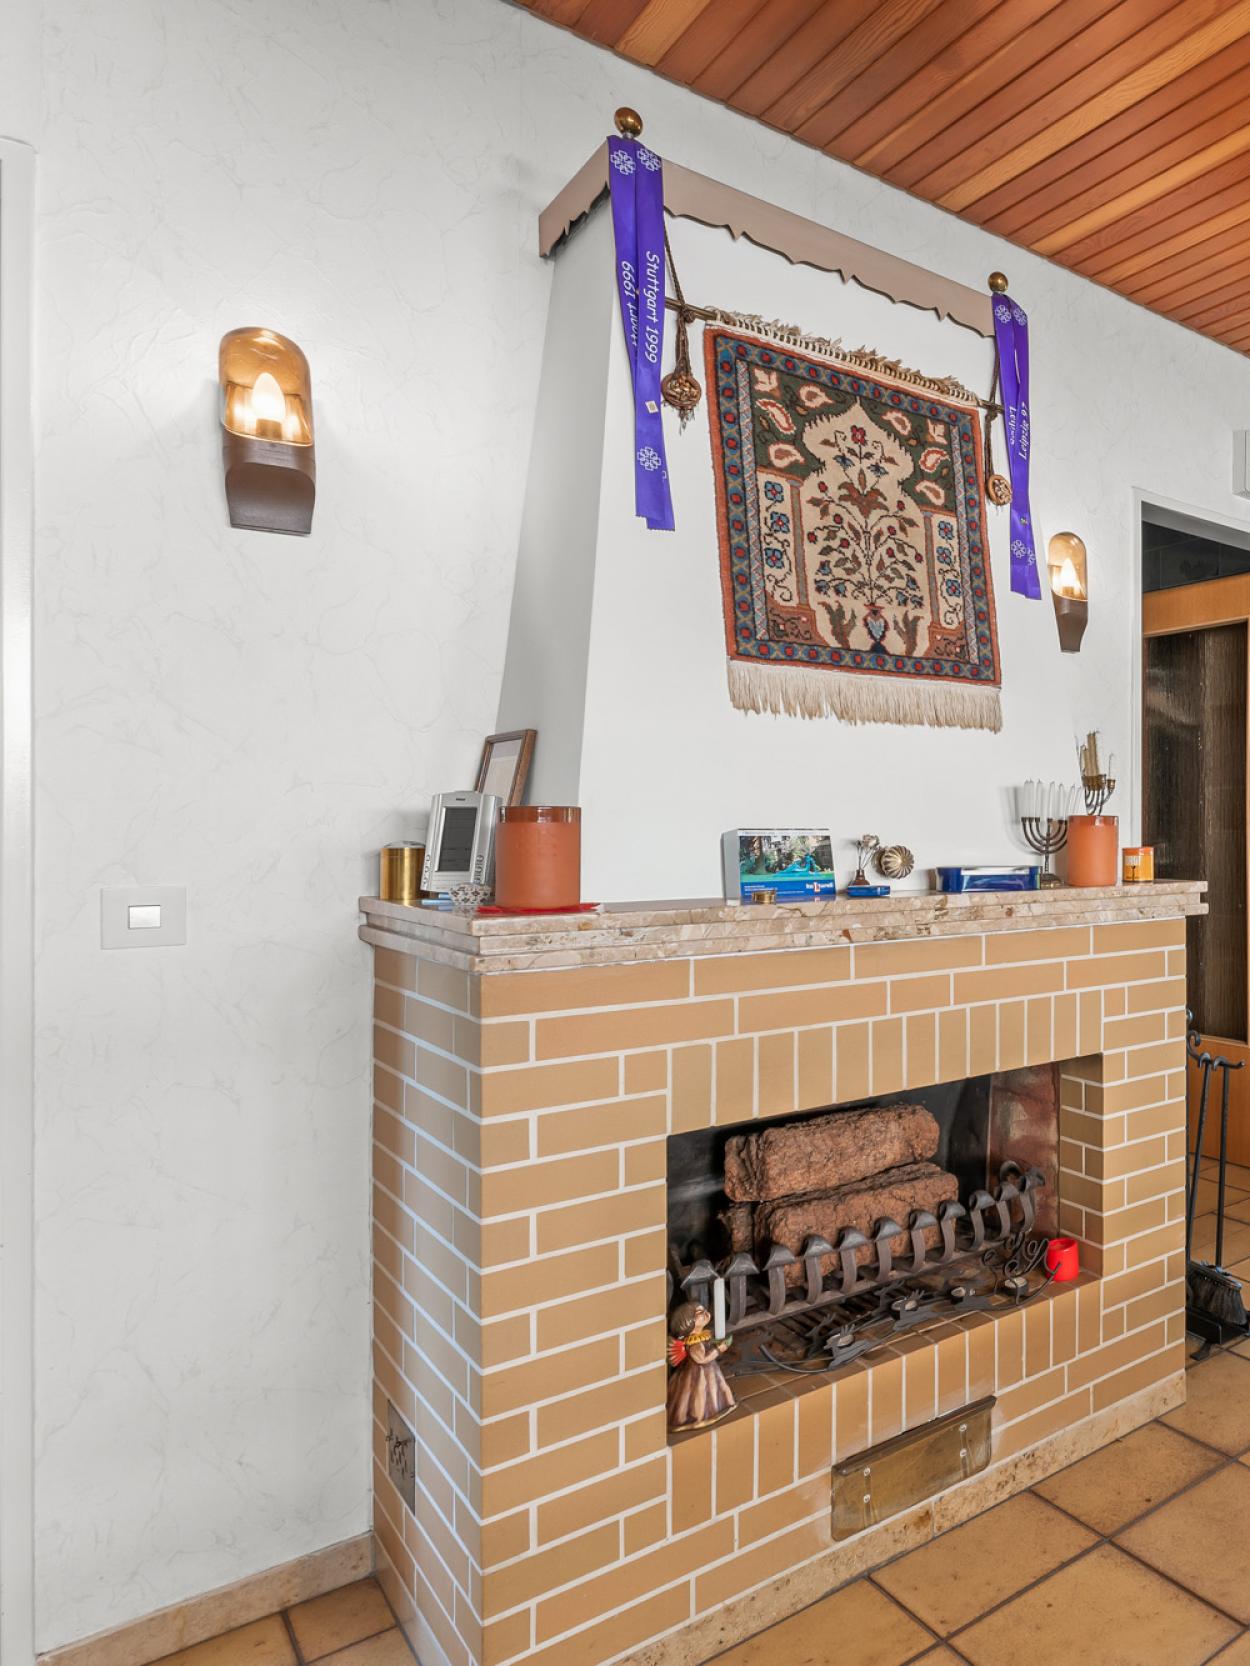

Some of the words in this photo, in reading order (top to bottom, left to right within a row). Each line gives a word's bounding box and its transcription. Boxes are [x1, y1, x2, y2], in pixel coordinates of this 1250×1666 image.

[621, 260, 636, 299] 1999
[644, 251, 660, 323] Stuttgart
[645, 325, 659, 363] 1999
